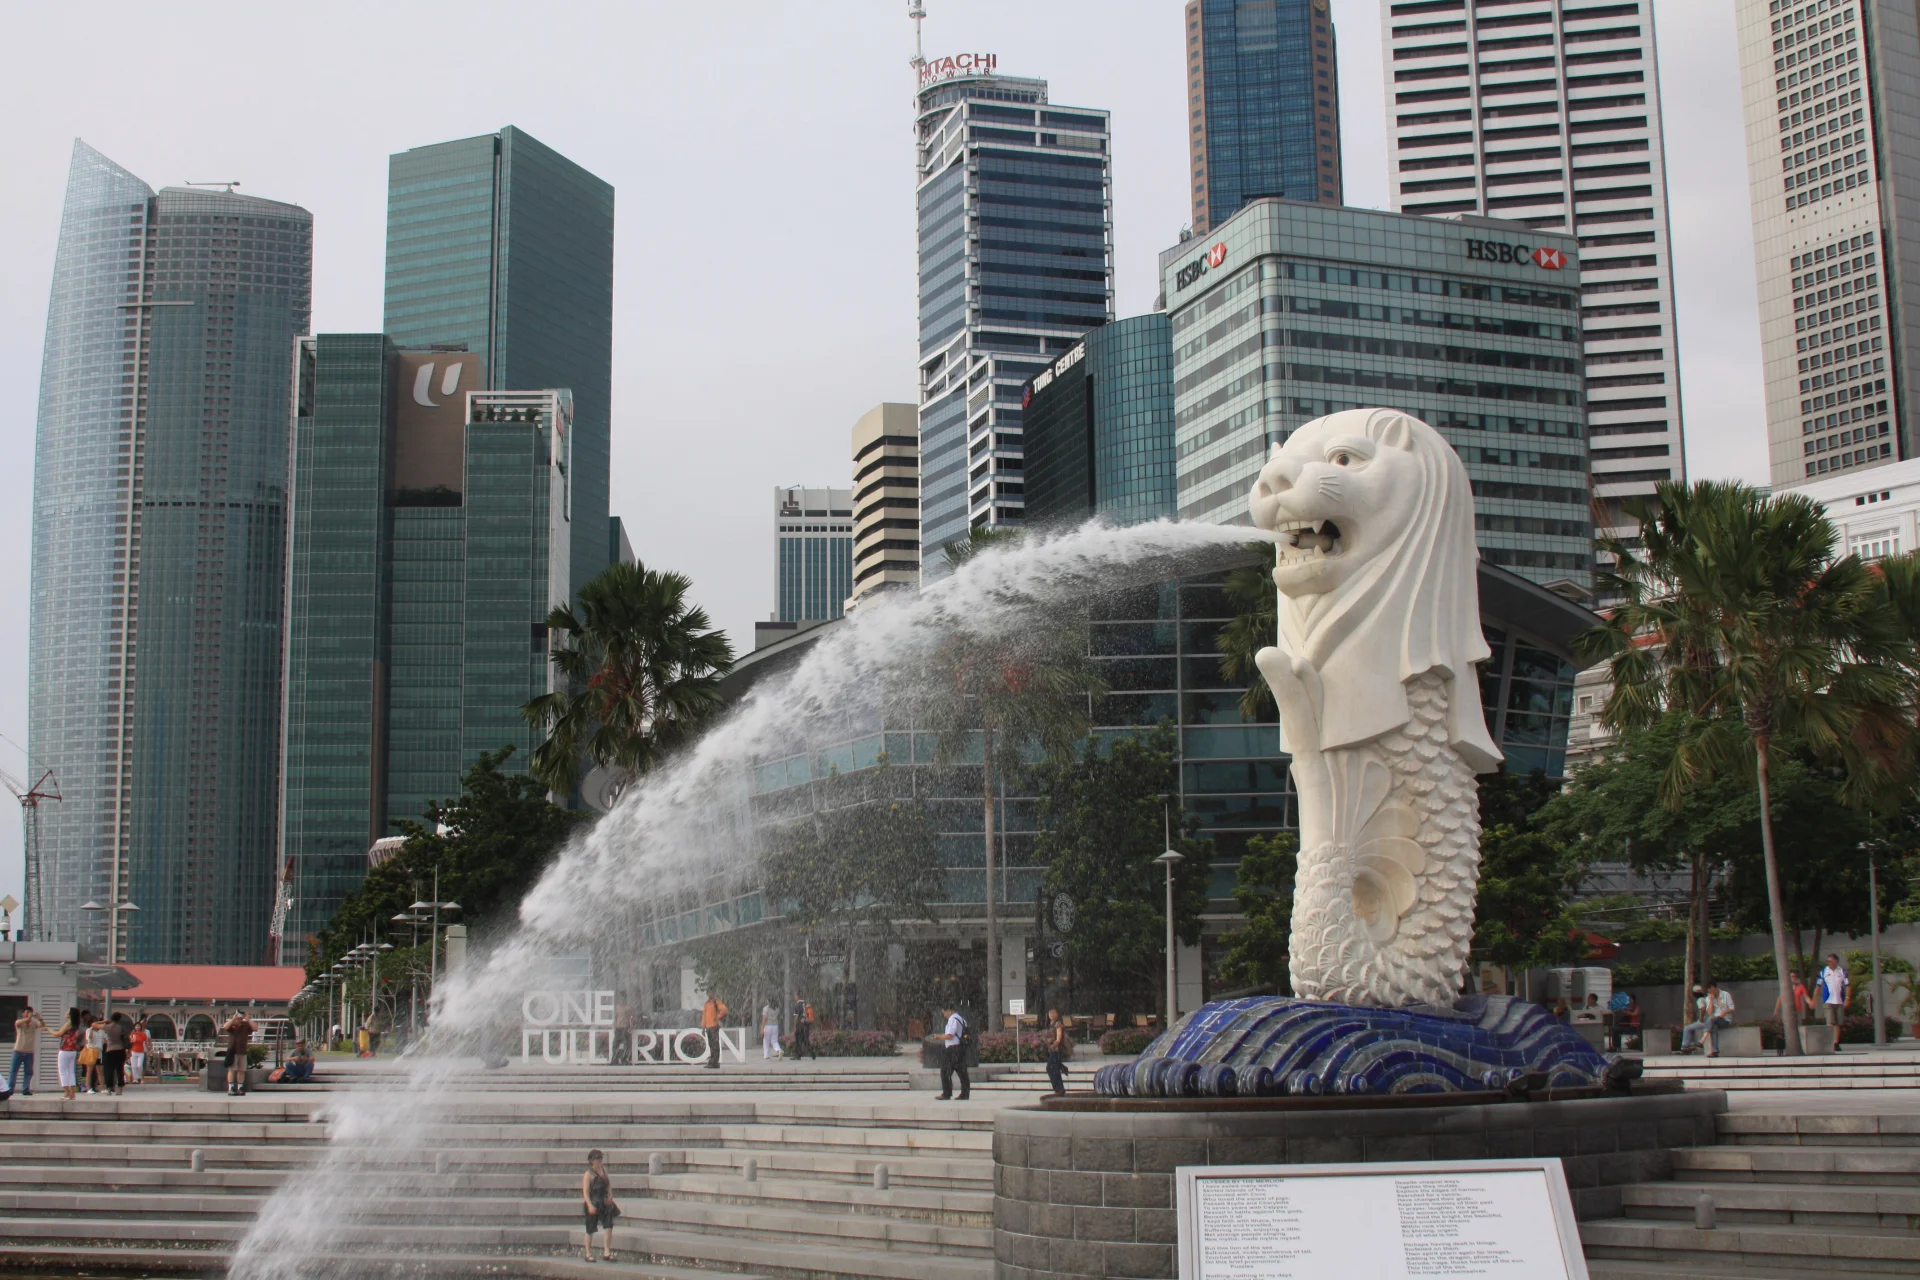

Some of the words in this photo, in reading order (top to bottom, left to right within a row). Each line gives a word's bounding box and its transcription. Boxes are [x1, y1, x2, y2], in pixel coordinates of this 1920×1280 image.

[919, 53, 997, 83] HITACHI
[1466, 239, 1530, 266] HSBC
[1176, 253, 1208, 292] HSBC
[1033, 368, 1053, 394] TUNG
[1055, 341, 1086, 377] CENTRE
[522, 991, 615, 1027] ONE
[522, 1028, 746, 1065] FULLRTON
